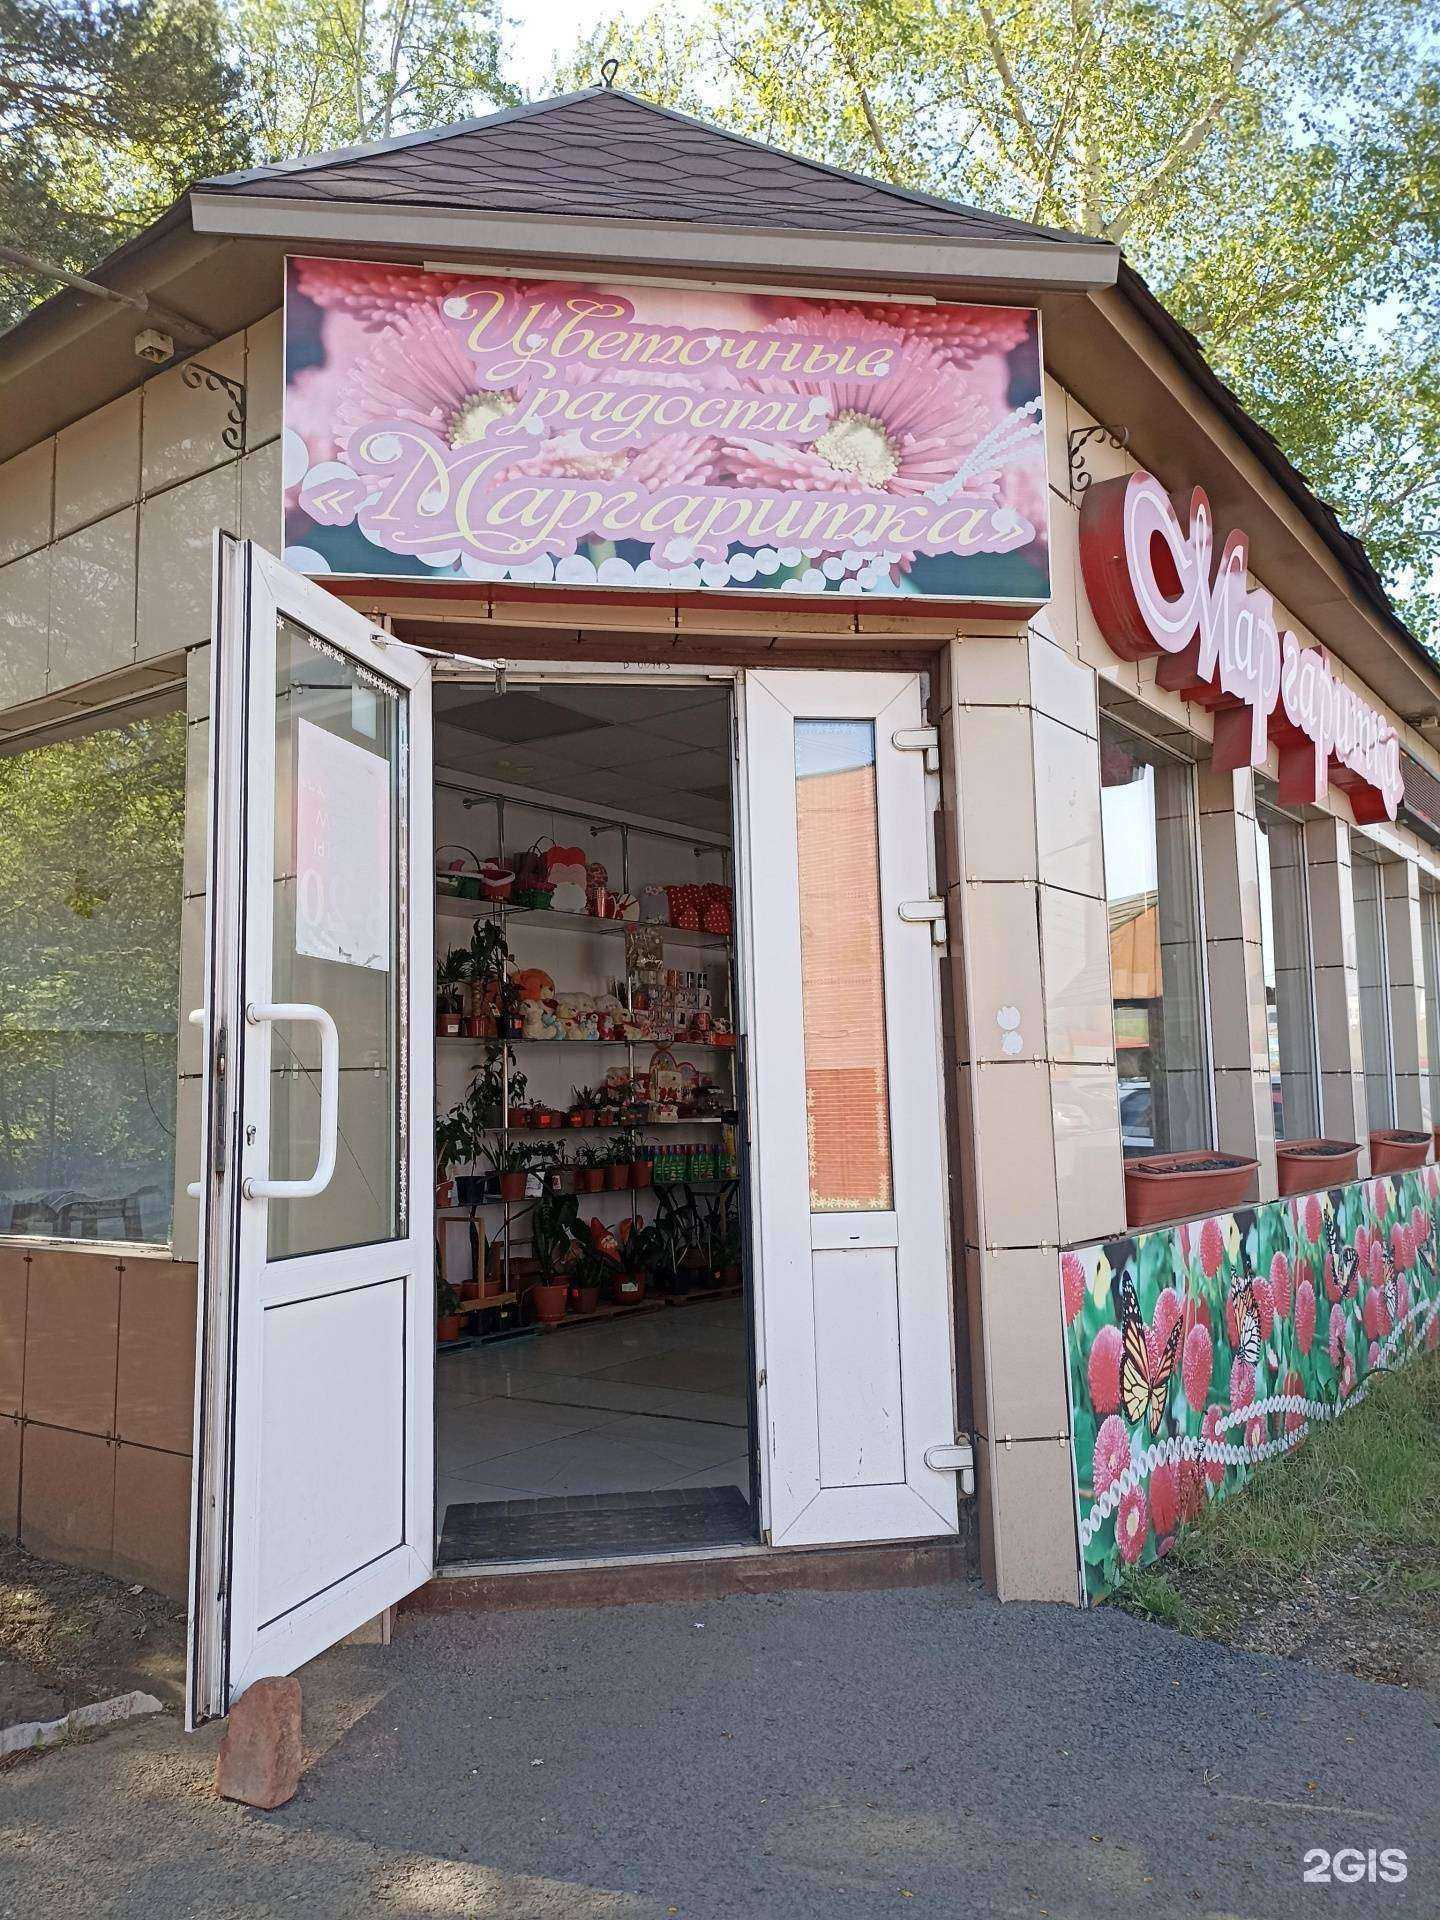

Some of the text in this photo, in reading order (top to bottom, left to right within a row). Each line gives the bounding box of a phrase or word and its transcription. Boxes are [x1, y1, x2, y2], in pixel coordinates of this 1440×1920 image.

[444, 290, 895, 381] Цветочные
[496, 385, 824, 443] радости
[311, 431, 1024, 555] «Маргаритка»
